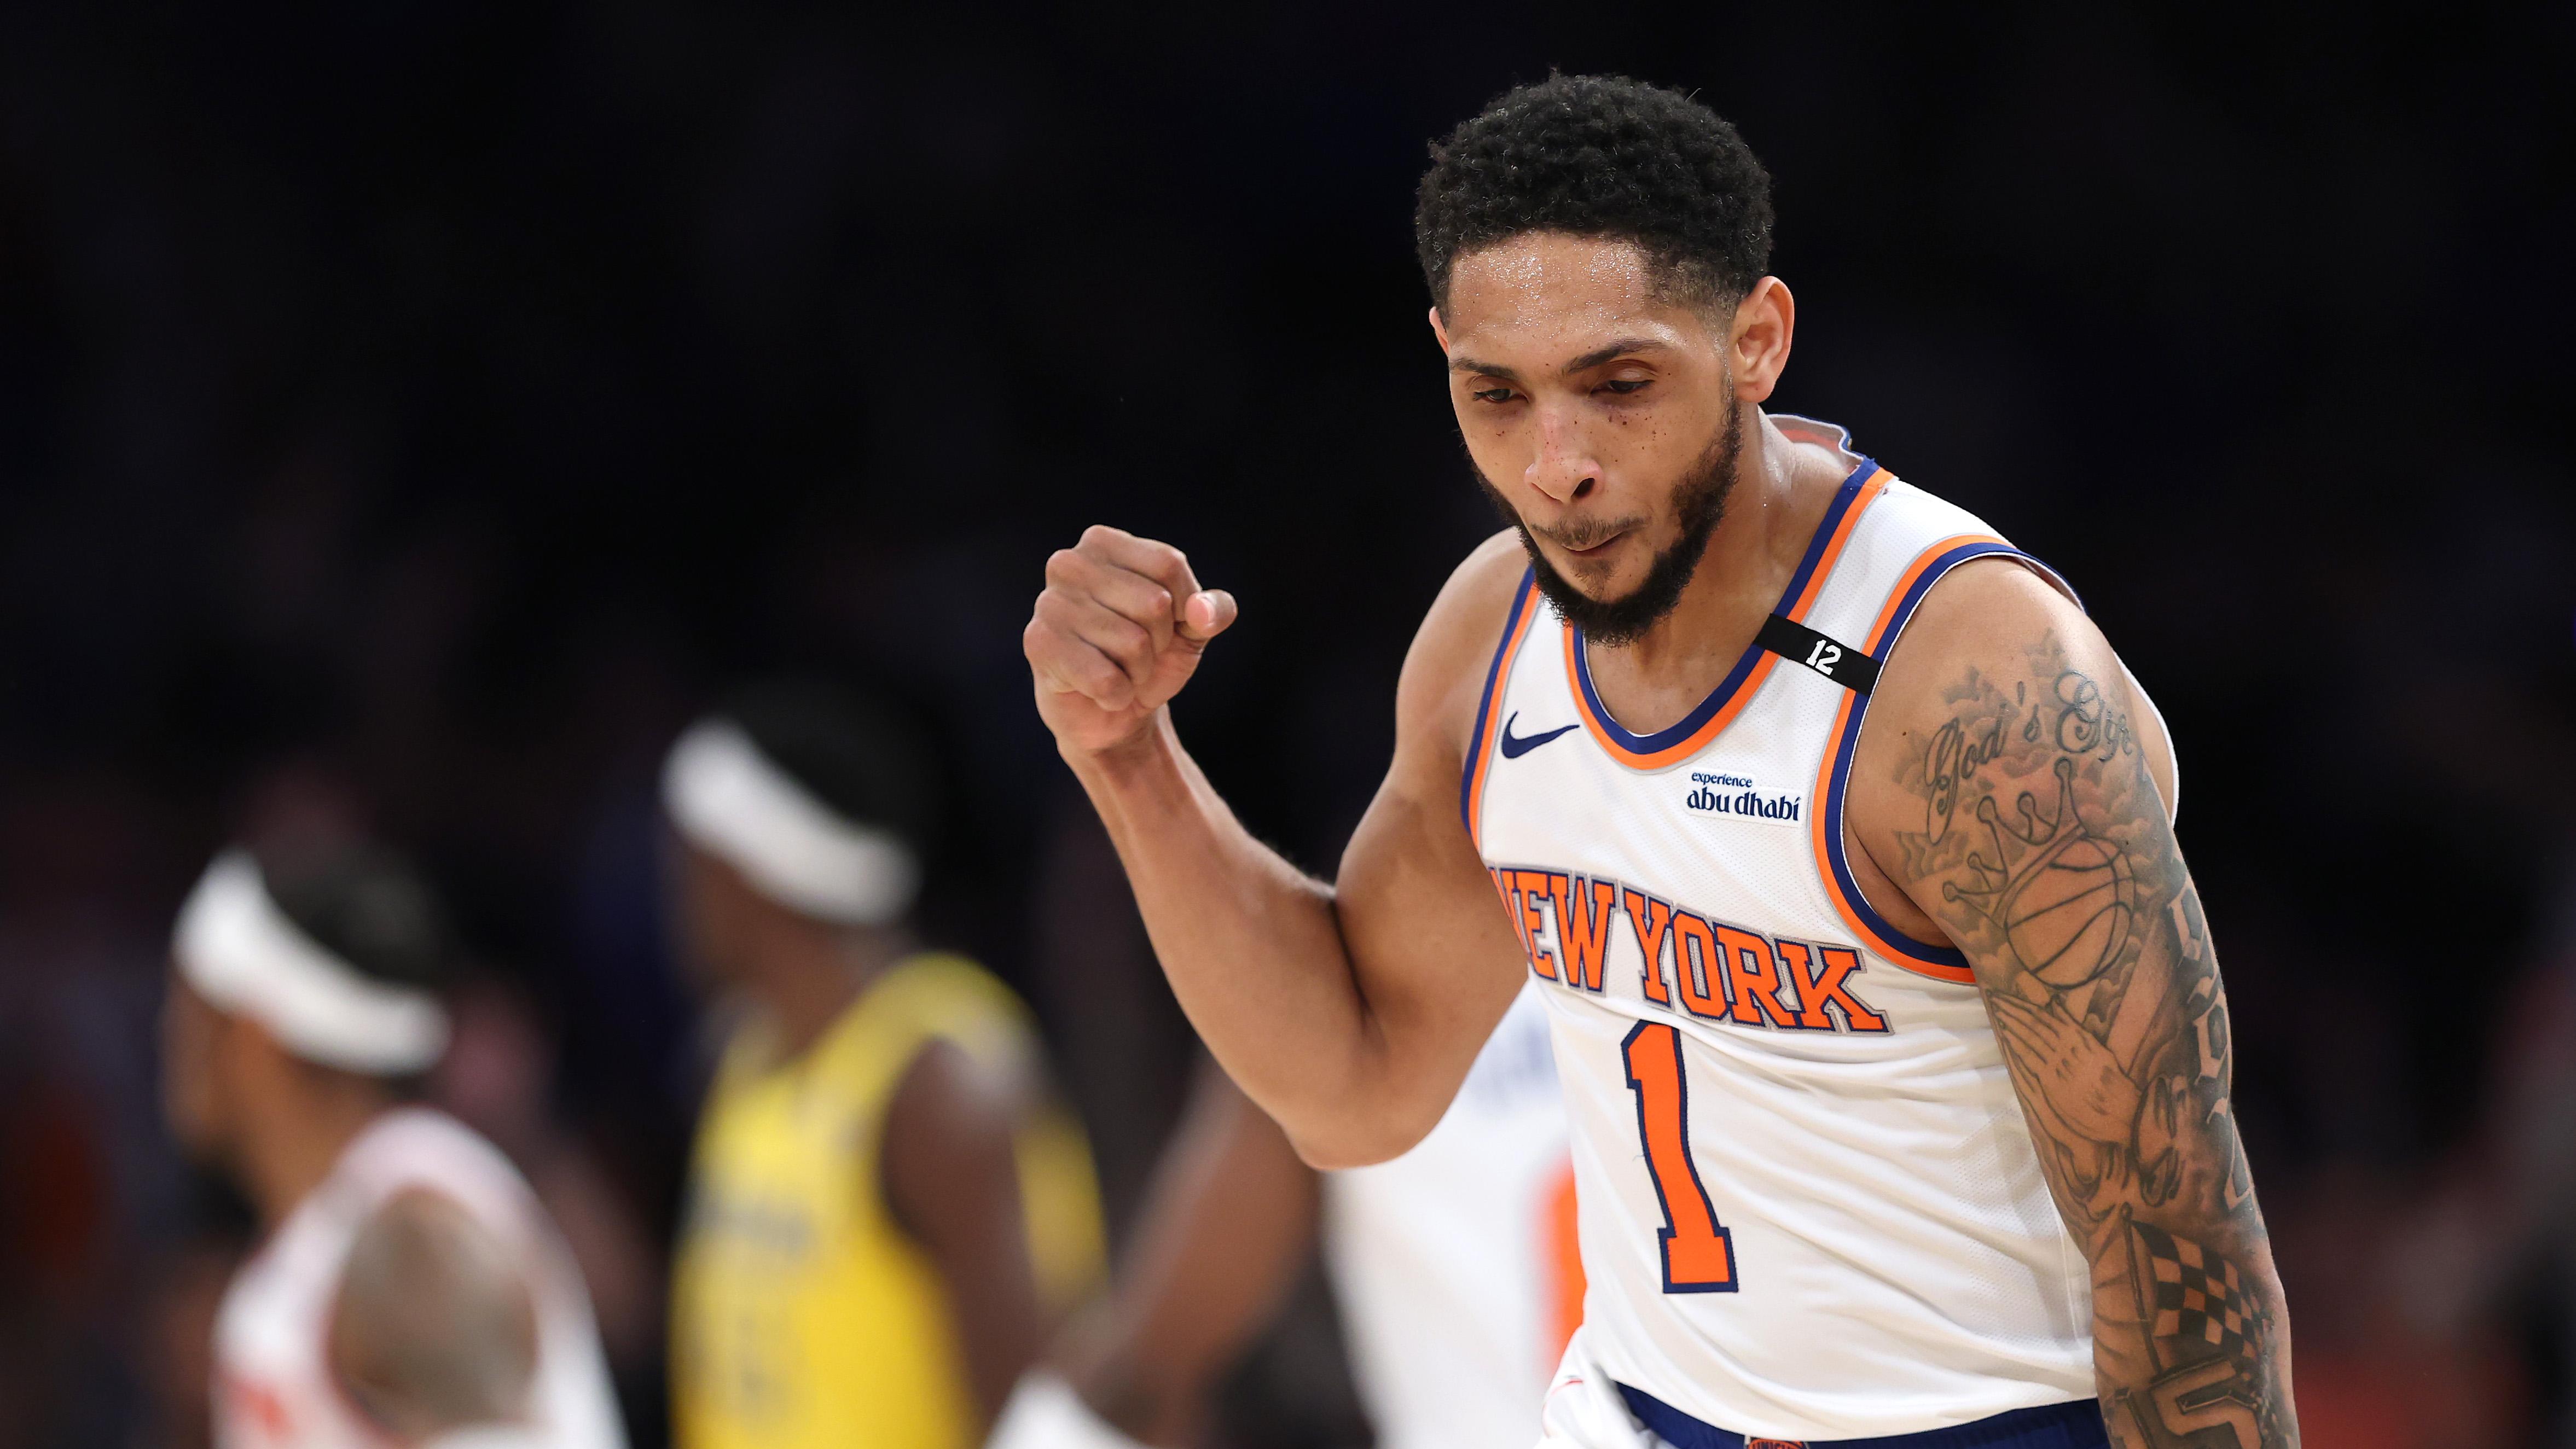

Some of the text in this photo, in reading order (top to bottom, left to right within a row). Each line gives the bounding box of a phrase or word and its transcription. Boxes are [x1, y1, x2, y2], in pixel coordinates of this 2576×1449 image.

[1805, 639, 1842, 676] 12
[1687, 787, 1801, 821] abu dhabi
[1691, 772, 1753, 788] experience
[1924, 680, 2040, 846] God's
[1622, 885, 1890, 1033] YORK
[1621, 1019, 1739, 1293] 1
